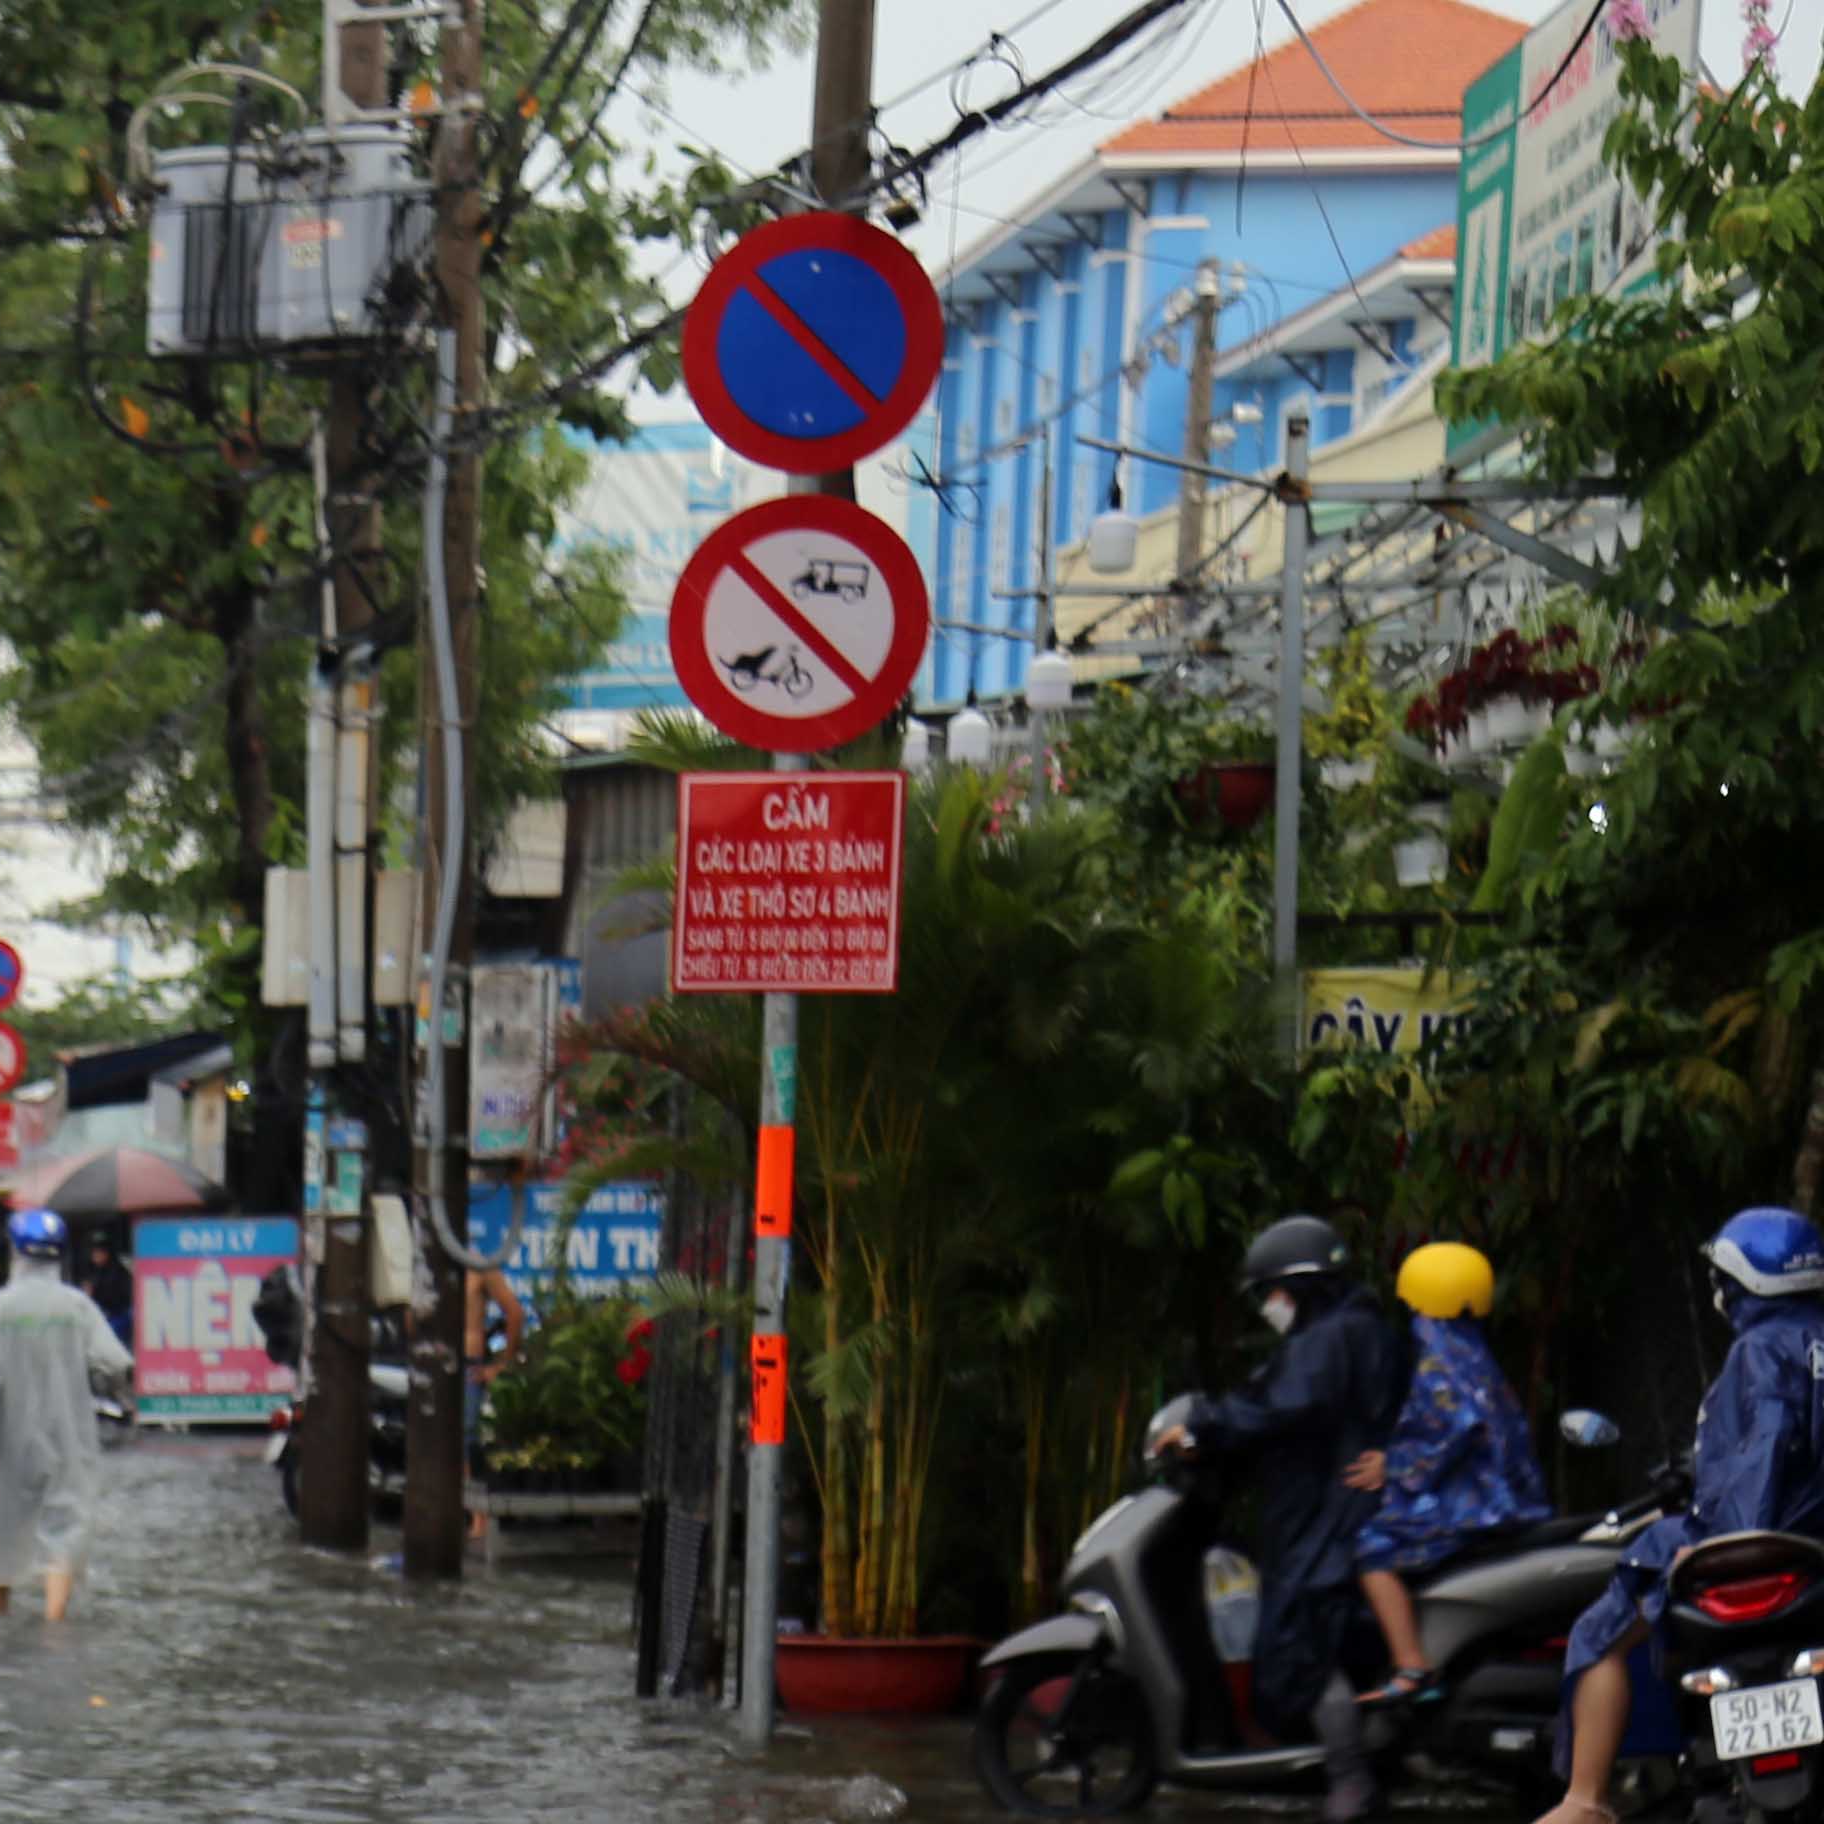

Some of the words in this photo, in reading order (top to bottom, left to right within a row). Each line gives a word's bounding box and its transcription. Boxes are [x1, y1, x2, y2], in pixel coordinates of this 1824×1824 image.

[762, 780, 830, 831] CẤM
[695, 834, 736, 874] CÁC
[737, 841, 782, 880] LOẠI
[785, 841, 811, 873] XE
[814, 841, 827, 873] 3
[689, 878, 717, 919] VÀ
[719, 886, 744, 919] XE
[818, 887, 831, 919] 4
[1727, 1689, 1803, 1723] 50-N2
